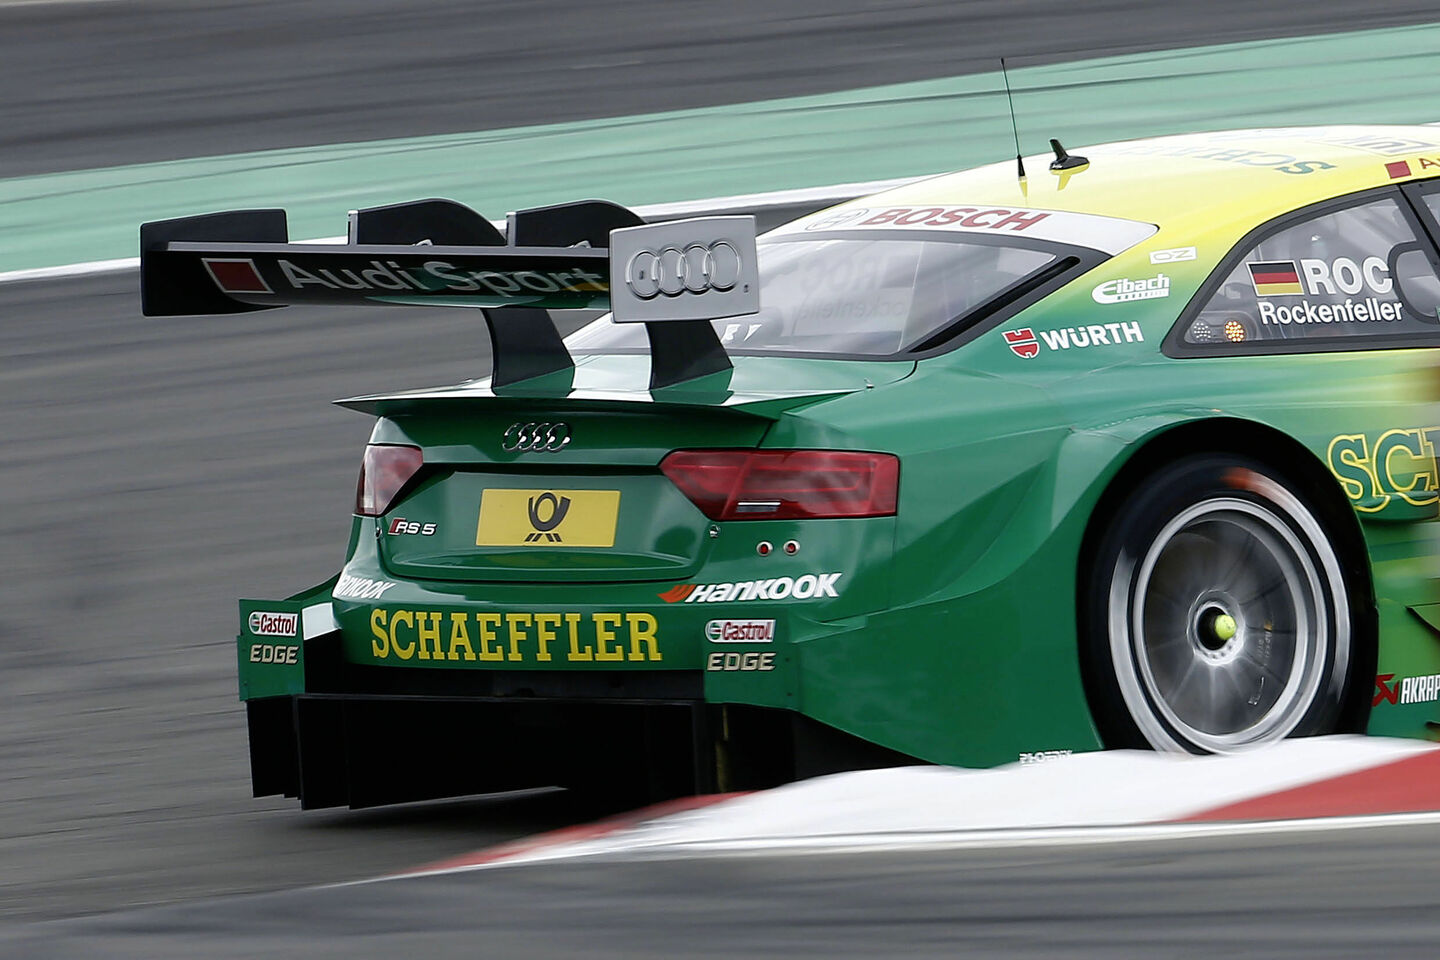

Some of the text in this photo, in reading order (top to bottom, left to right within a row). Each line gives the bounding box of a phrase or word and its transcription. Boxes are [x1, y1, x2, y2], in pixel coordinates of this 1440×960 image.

[858, 207, 1052, 232] BOSCH
[1152, 249, 1194, 262] OZ
[277, 258, 608, 298] Audi Sport
[1091, 273, 1170, 304] Eibach
[1300, 256, 1394, 296] ROC
[1257, 297, 1404, 326] Rockenfeller
[1039, 320, 1144, 351] WÜRTH
[393, 519, 437, 536] RS 5
[260, 613, 296, 635] Castrol
[370, 608, 663, 662] SCHAEFFLER
[722, 621, 773, 641] Castrol
[249, 644, 300, 665] EDGE
[706, 652, 777, 671] EDGE
